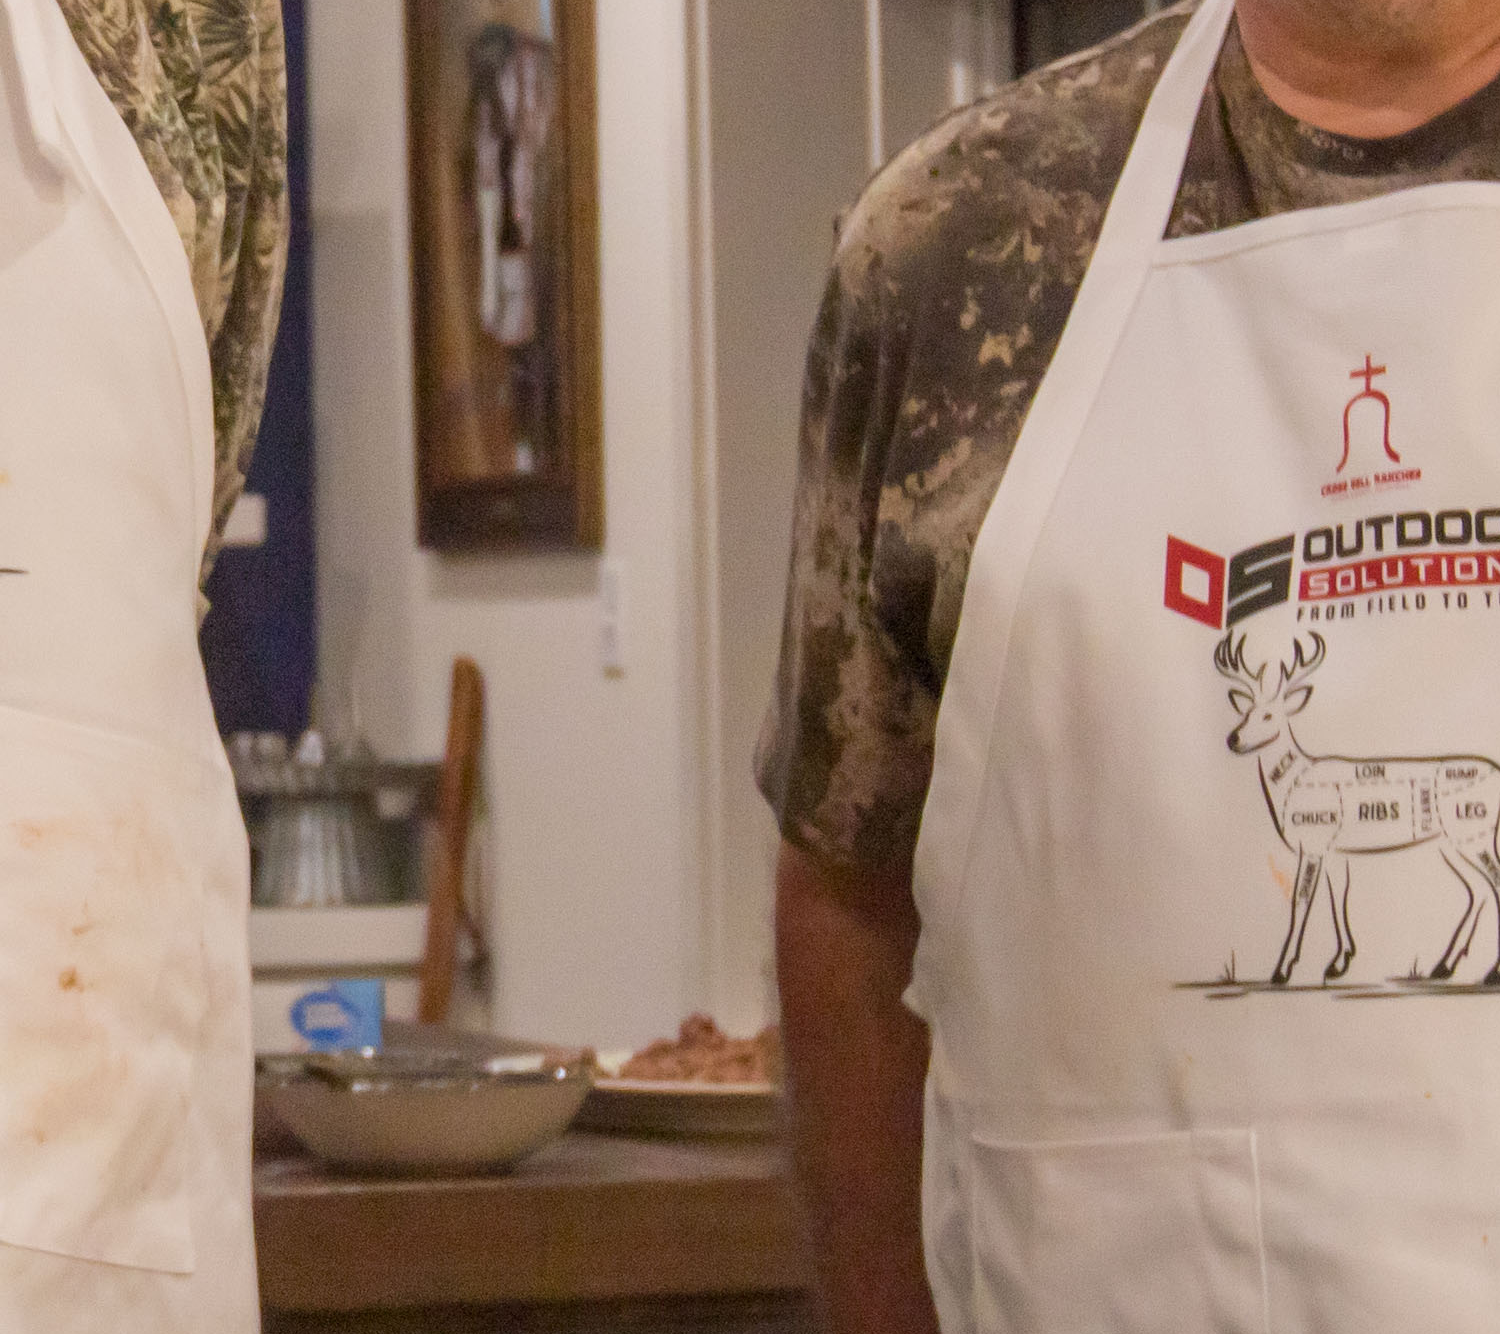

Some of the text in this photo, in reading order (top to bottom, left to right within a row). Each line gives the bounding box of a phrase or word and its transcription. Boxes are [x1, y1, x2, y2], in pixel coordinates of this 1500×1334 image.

[1163, 533, 1296, 631] OS
[1297, 604, 1356, 623] FROM
[1367, 591, 1426, 615] FIELD
[1443, 590, 1469, 609] TO
[1355, 764, 1386, 780] LOIN
[1445, 767, 1479, 780] RUMP
[1291, 811, 1338, 826] CHUCK
[1358, 801, 1400, 821] RIBS
[1455, 802, 1488, 819] LEG
